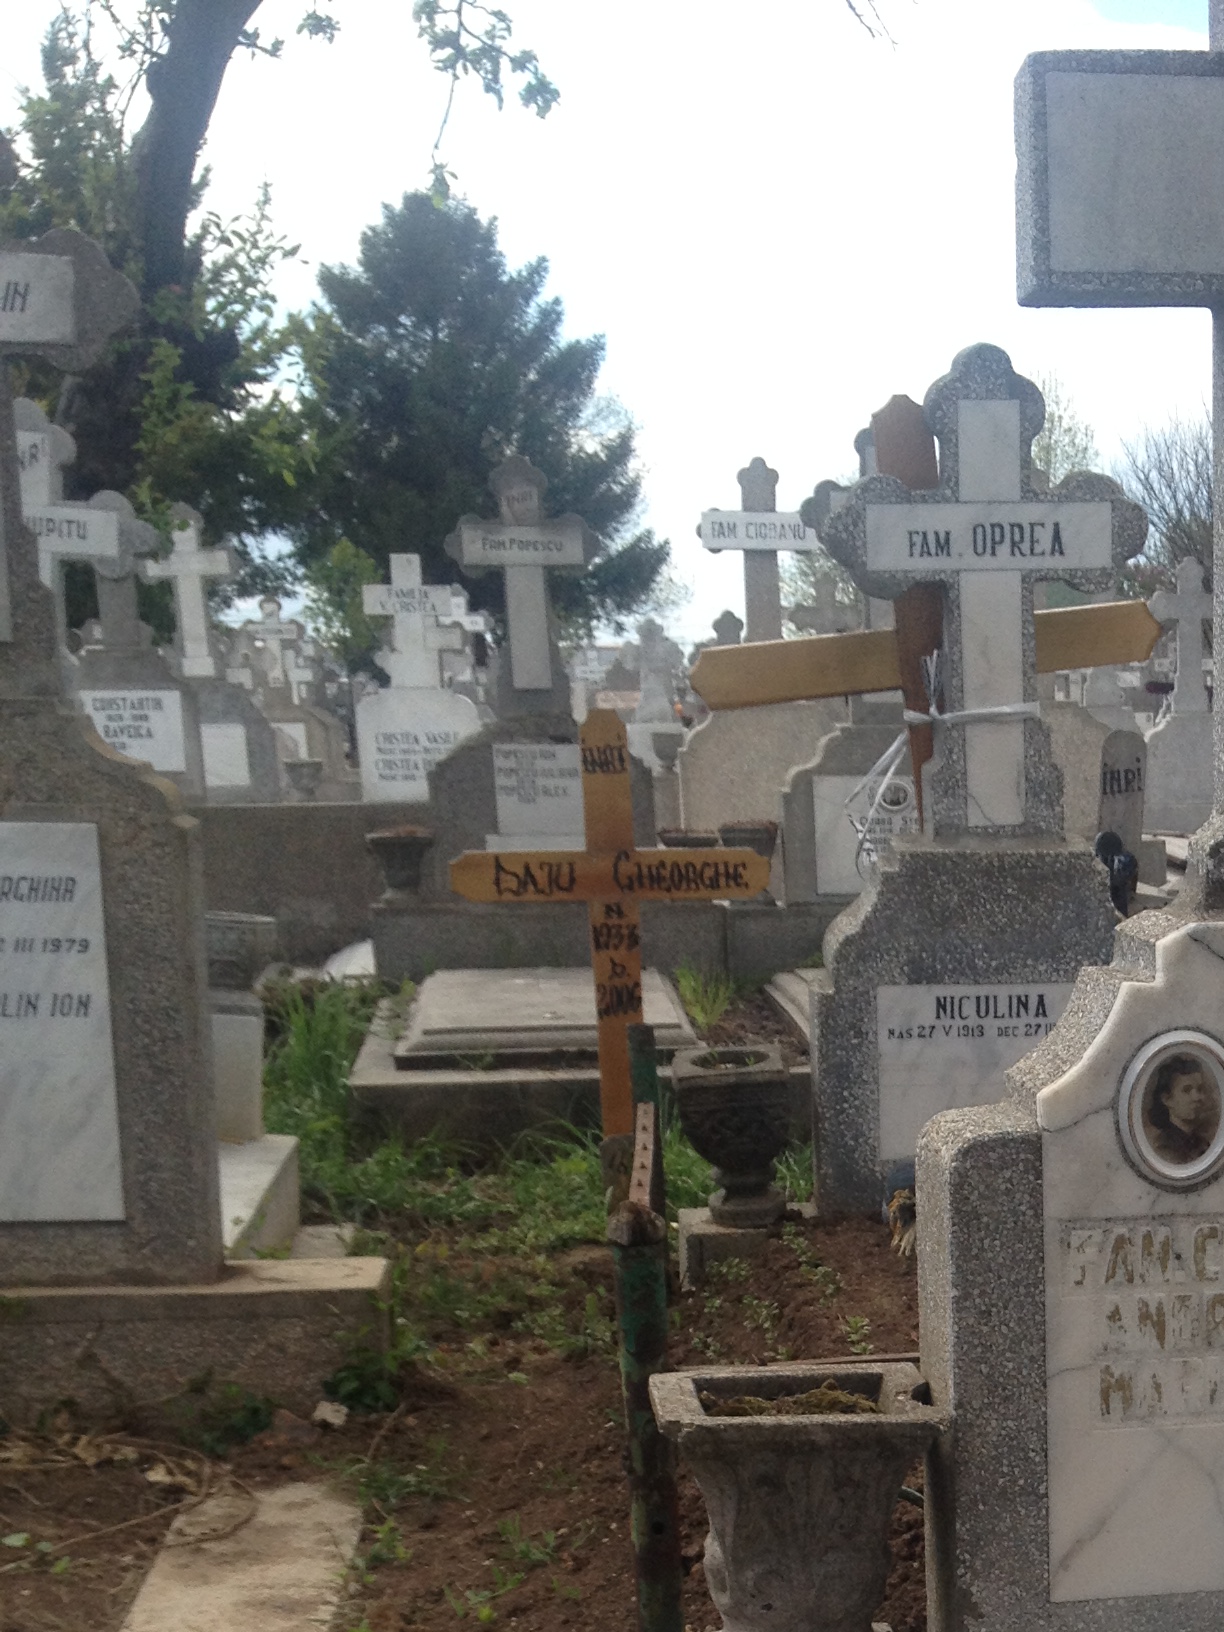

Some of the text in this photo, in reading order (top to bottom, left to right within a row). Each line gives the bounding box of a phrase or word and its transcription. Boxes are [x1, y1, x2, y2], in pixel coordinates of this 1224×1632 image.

[972, 522, 1065, 557] OPREA
[42, 937, 90, 954] 1979
[935, 993, 1049, 1020] NICULINA
[888, 1026, 913, 1040] NAS
[957, 1023, 985, 1038] 1913
[997, 1026, 1020, 1038] DEC
